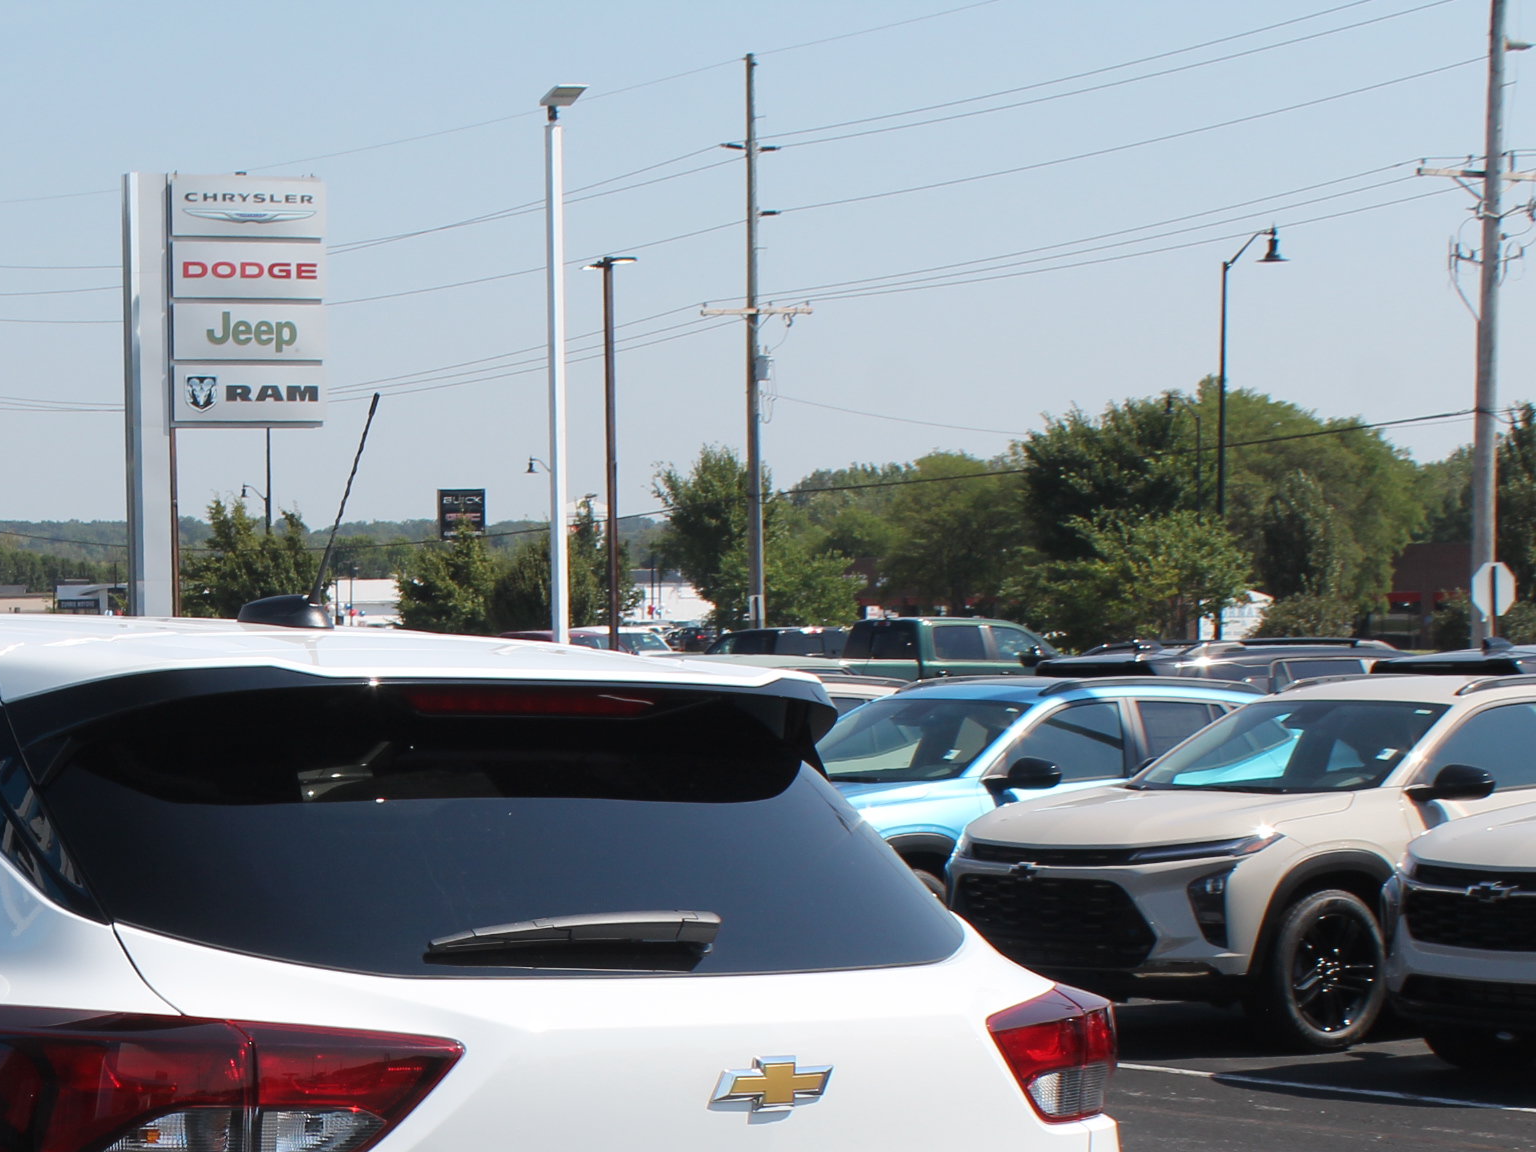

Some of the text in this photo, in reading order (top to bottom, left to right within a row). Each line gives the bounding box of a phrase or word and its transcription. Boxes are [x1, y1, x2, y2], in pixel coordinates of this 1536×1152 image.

[184, 192, 314, 204] CHRYSLER
[182, 261, 318, 280] DODGE
[206, 311, 297, 353] Jeep
[225, 385, 319, 402] RAM
[443, 496, 482, 504] BUICK
